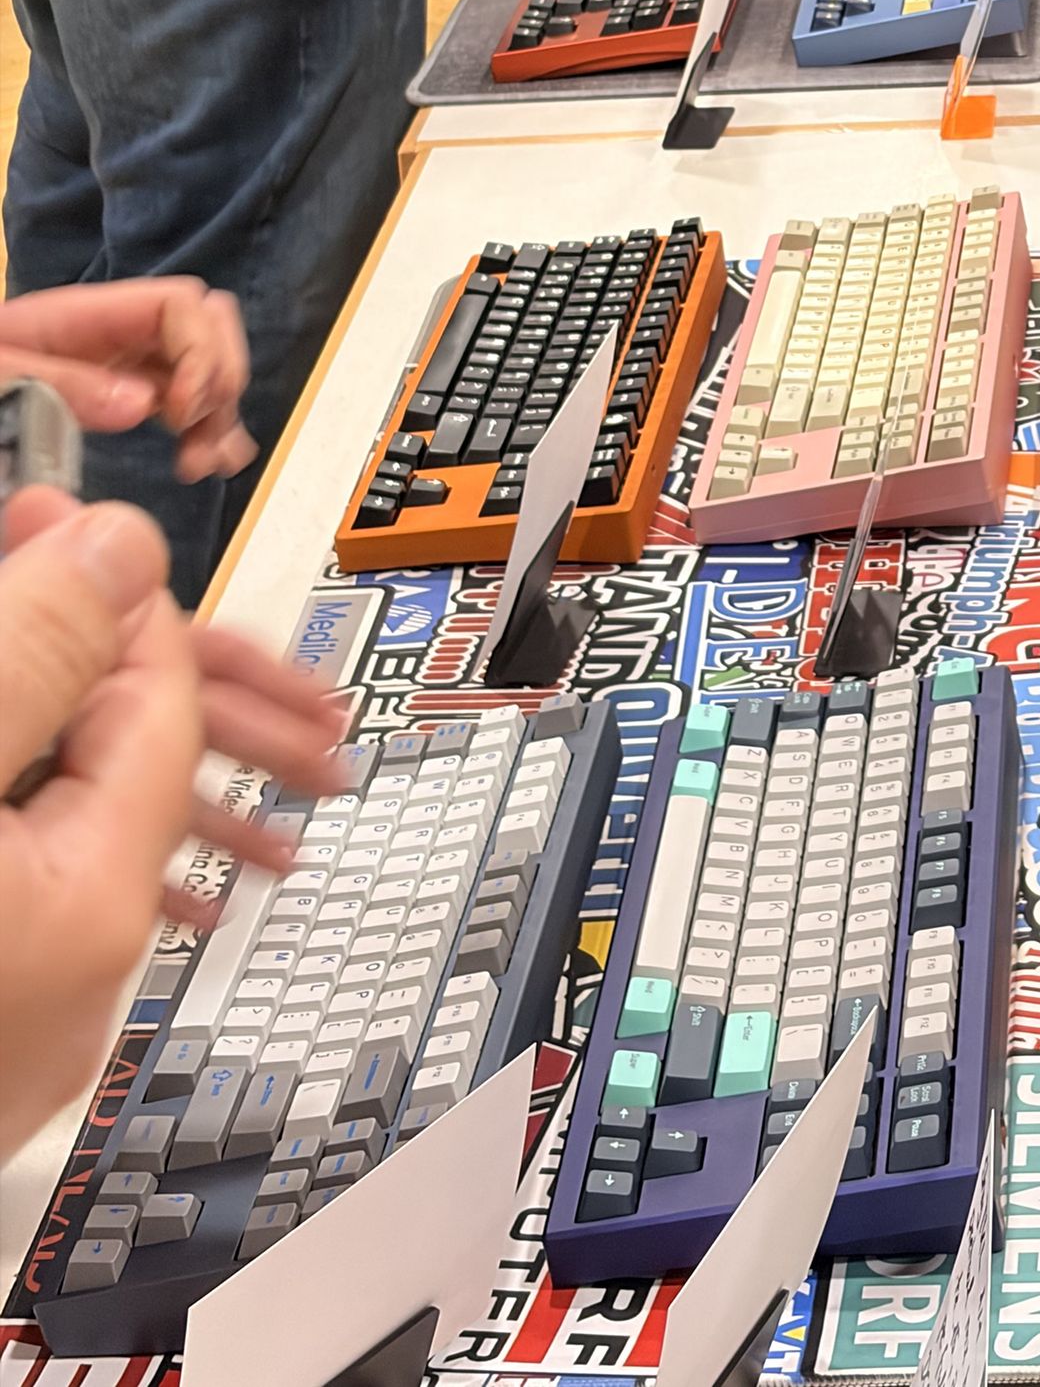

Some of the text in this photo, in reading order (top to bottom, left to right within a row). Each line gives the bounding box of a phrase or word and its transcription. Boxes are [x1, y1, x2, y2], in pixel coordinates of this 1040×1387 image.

[844, 716, 858, 724] Q
[796, 730, 810, 739] A
[842, 737, 856, 746] W
[746, 748, 762, 757] Z
[442, 757, 457, 765] Q
[792, 753, 807, 762] S
[838, 760, 853, 769] E
[392, 776, 407, 784] A
[743, 771, 758, 780] X
[432, 780, 446, 790] W
[788, 776, 804, 785] D
[834, 784, 850, 794] R
[338, 796, 354, 804] Z
[383, 800, 398, 808] S
[738, 796, 754, 806] C
[785, 800, 800, 808] F
[424, 804, 438, 814] E
[832, 810, 847, 818] T
[328, 822, 344, 830] X
[373, 824, 388, 833] D
[734, 820, 749, 829] V
[415, 830, 430, 838] R
[780, 825, 796, 834] G
[828, 833, 844, 842] Y
[317, 846, 333, 856] C
[729, 844, 746, 852] B
[364, 849, 378, 857] F
[777, 850, 792, 858] H
[405, 854, 420, 862] T
[824, 859, 840, 868] U
[308, 872, 323, 880] V
[353, 875, 368, 884] G
[725, 870, 740, 880] N
[396, 880, 412, 888] Y
[774, 876, 790, 884] J
[296, 898, 312, 906] B
[342, 901, 358, 910] H
[720, 896, 736, 908] M
[386, 907, 401, 916] U
[768, 902, 785, 912] K
[817, 912, 833, 922] O
[285, 924, 302, 933] N
[332, 928, 347, 936] J
[764, 929, 780, 937] L
[814, 939, 830, 948] P
[274, 952, 290, 962] M
[321, 956, 336, 964] K
[365, 962, 381, 972] O
[310, 982, 326, 992] L
[356, 990, 370, 999] P
[784, 1114, 796, 1127] End
[910, 1118, 922, 1138] Pause
